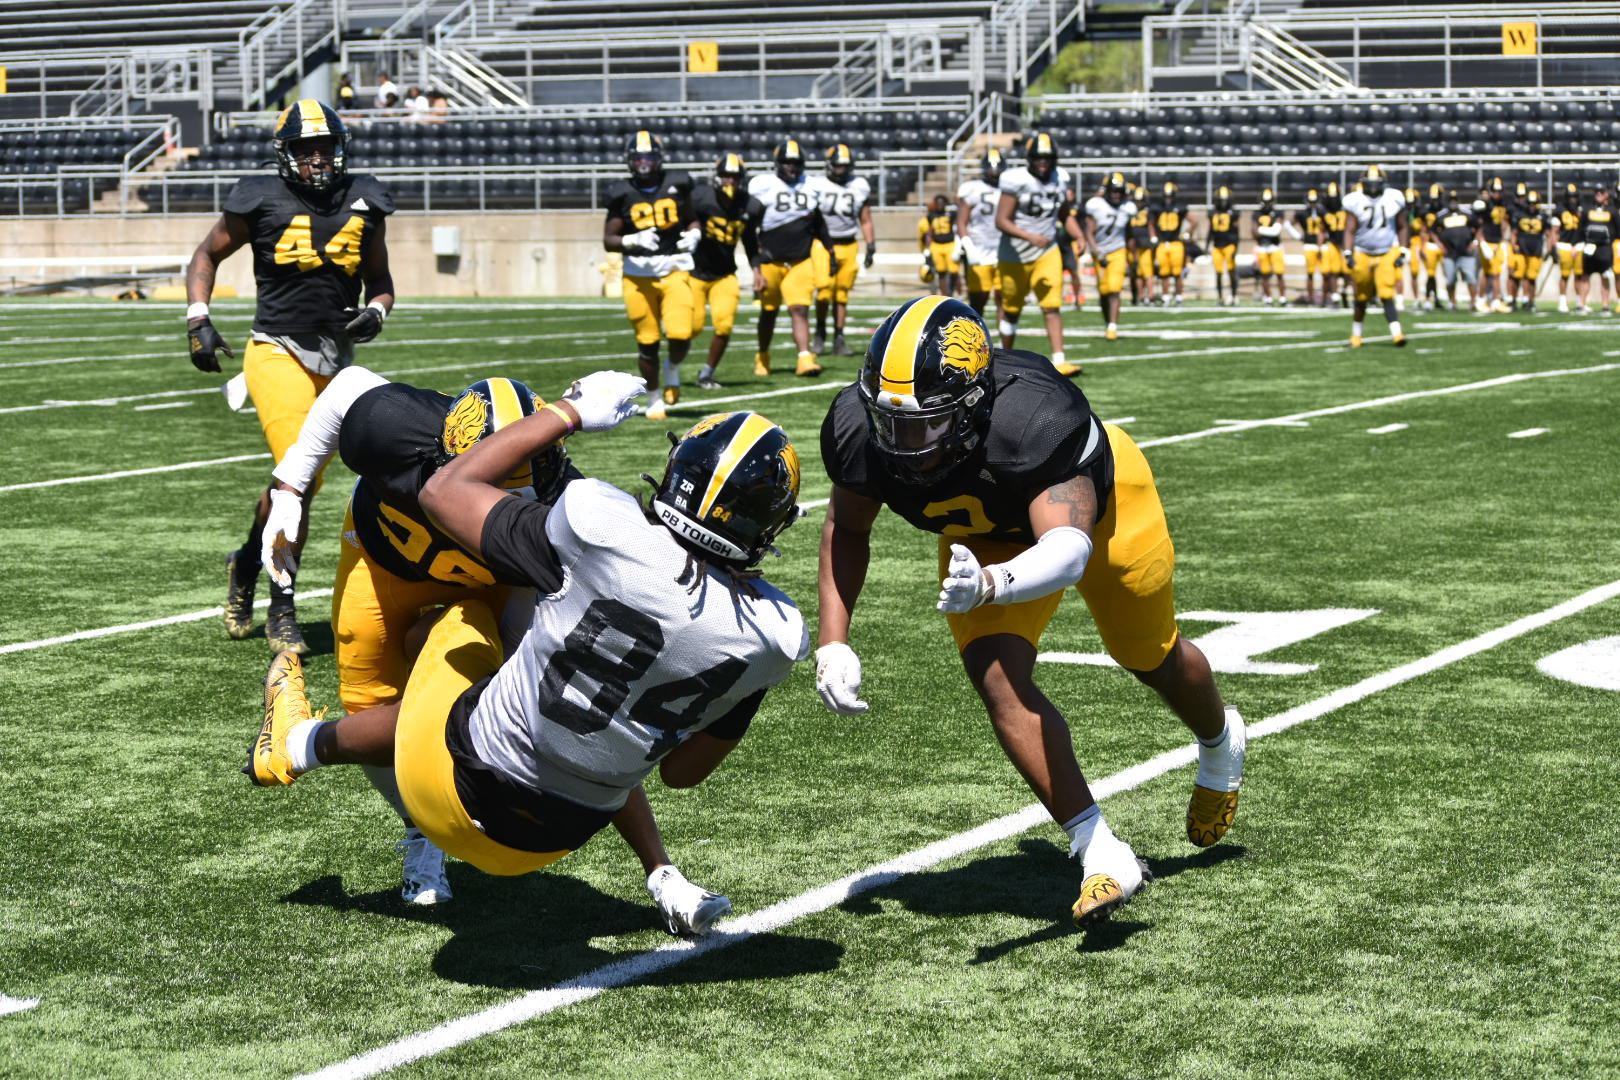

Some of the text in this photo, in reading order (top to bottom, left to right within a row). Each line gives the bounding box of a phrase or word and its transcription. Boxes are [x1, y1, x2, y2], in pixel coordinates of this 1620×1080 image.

[1508, 30, 1531, 47] W
[776, 191, 808, 213] 69
[825, 192, 855, 218] 73
[1363, 206, 1387, 229] 71
[274, 215, 366, 276] 44
[680, 478, 695, 495] ZR
[712, 506, 732, 523] 84
[661, 509, 732, 556] PB TOUGH
[538, 598, 750, 762] 84
